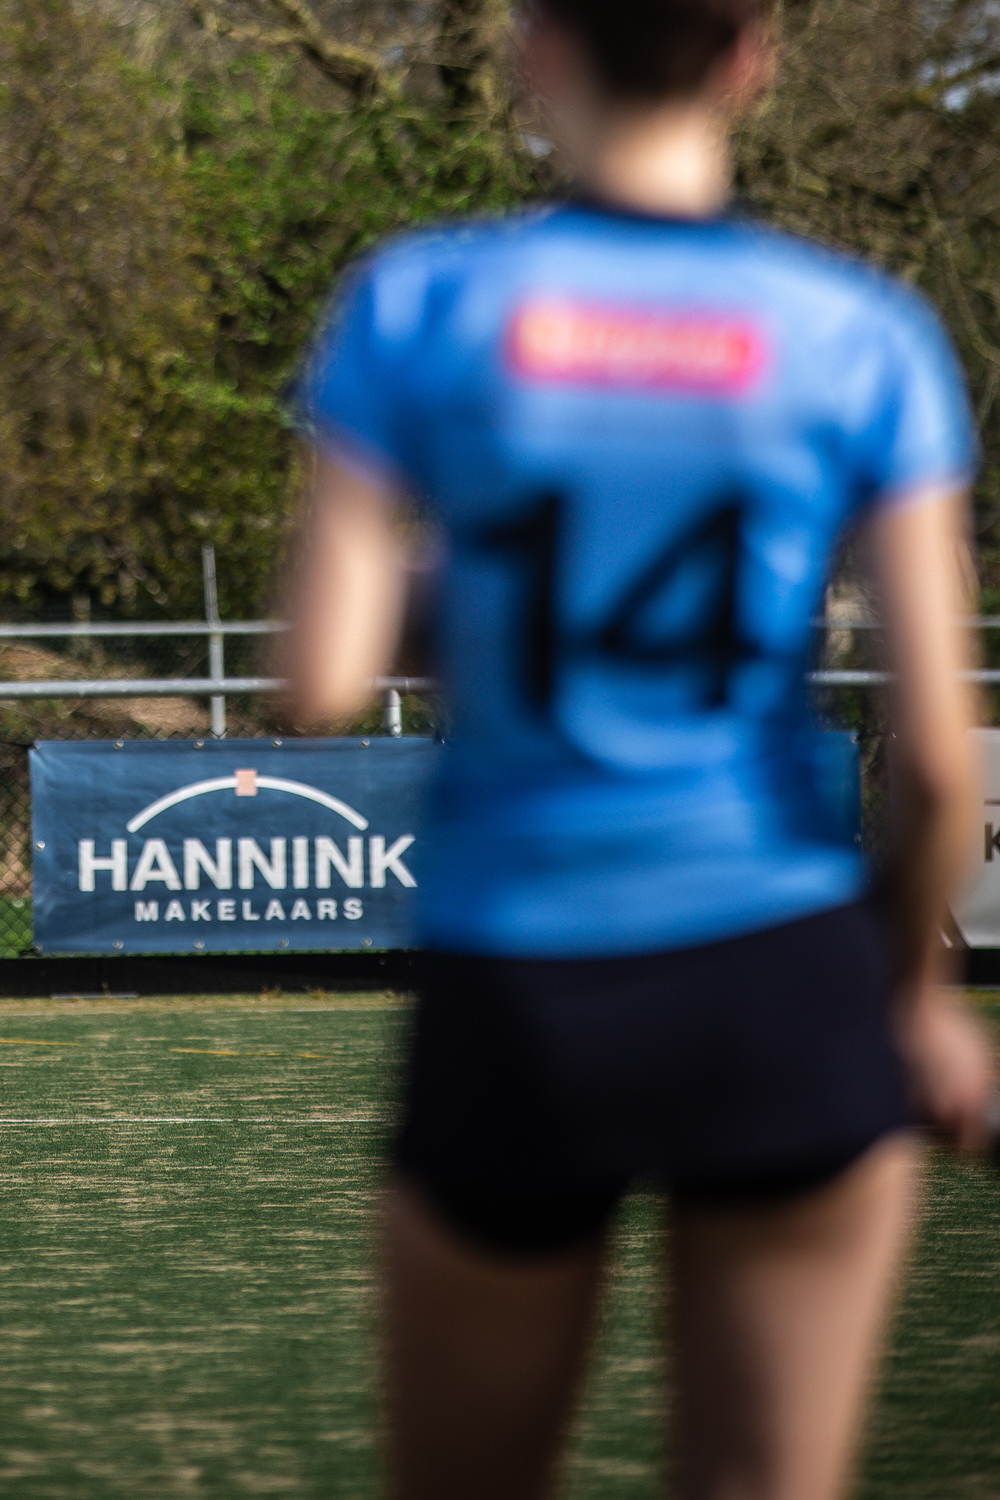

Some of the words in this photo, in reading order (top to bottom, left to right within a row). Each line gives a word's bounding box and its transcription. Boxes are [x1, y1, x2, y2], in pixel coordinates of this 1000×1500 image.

[482, 490, 763, 718] 14
[77, 833, 418, 893] HANNINK
[133, 897, 365, 923] MAKELAARS
